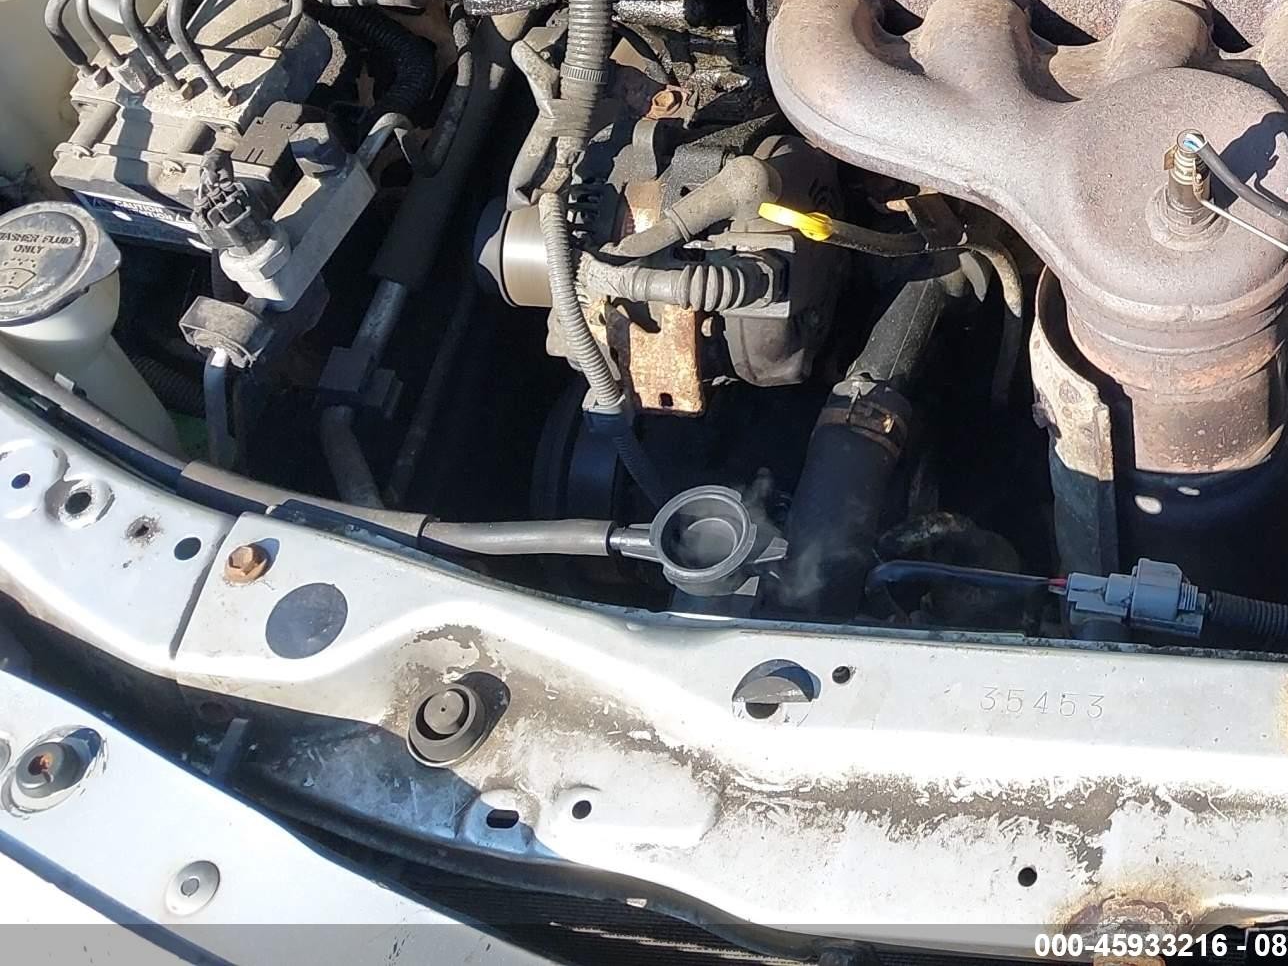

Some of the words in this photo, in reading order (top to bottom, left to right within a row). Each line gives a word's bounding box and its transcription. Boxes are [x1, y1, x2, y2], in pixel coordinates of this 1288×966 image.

[115, 200, 163, 214] CAUTION
[41, 235, 75, 245] FLUID
[13, 244, 45, 254] ONLY
[979, 685, 1105, 719] 35453
